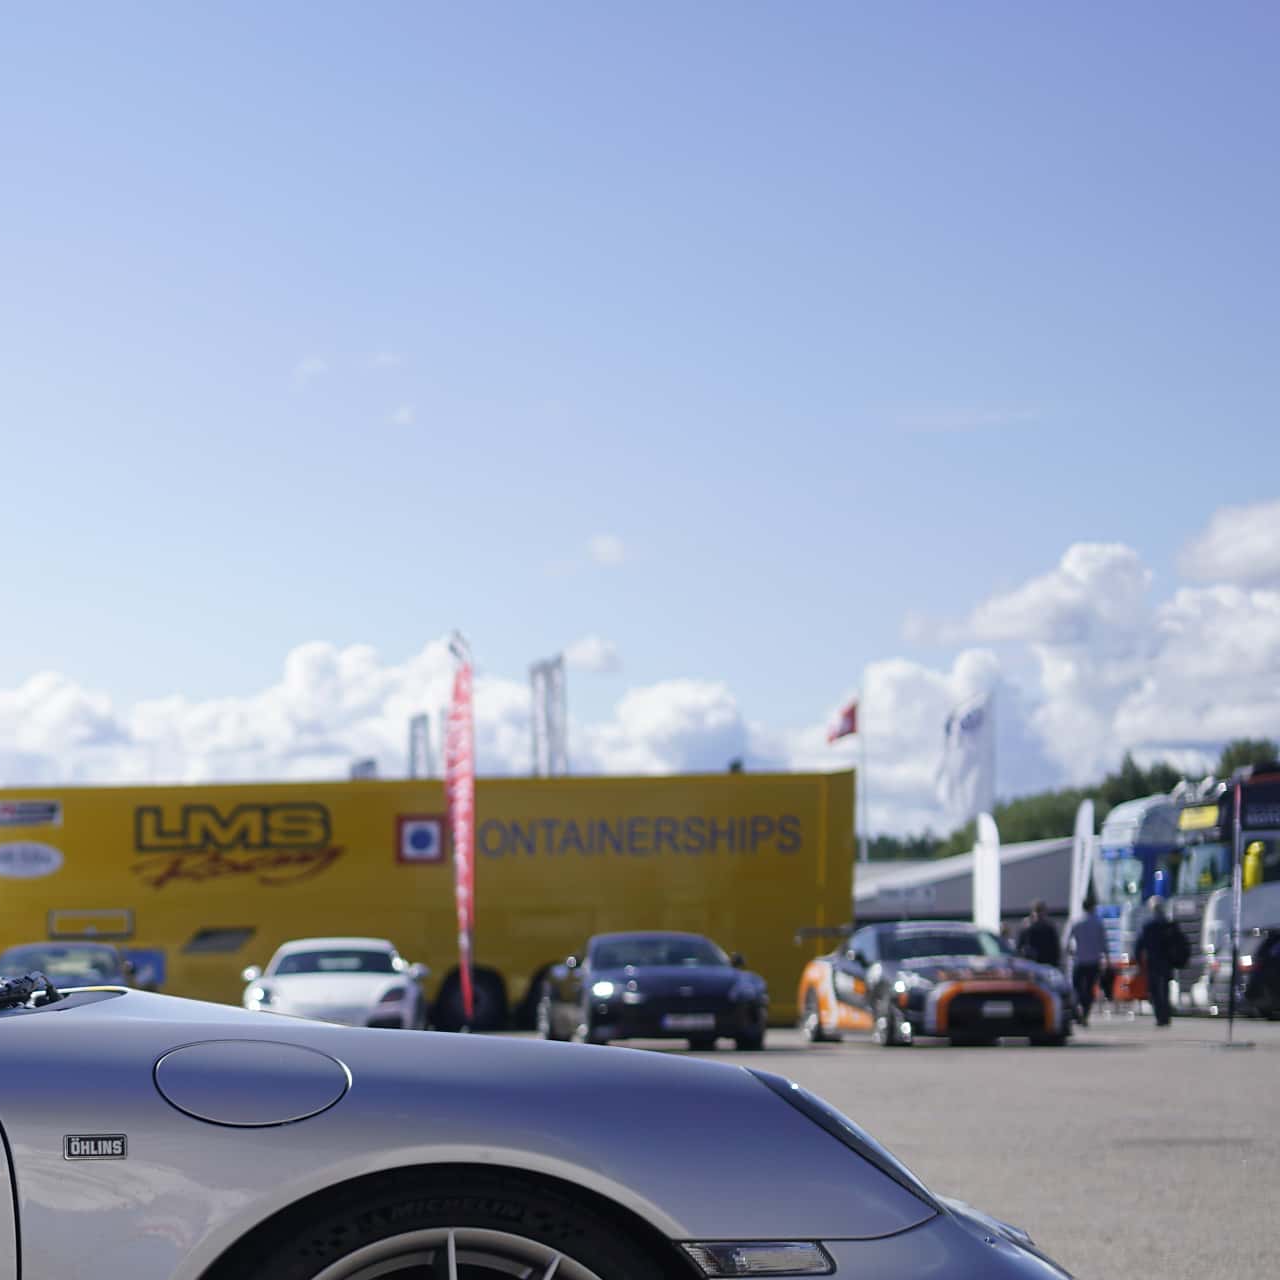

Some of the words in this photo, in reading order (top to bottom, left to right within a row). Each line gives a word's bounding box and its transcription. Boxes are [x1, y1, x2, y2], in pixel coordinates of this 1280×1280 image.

[134, 803, 332, 853] LMS
[478, 814, 803, 858] ONTAINERSHIPS
[70, 1138, 124, 1155] ÖHLINS
